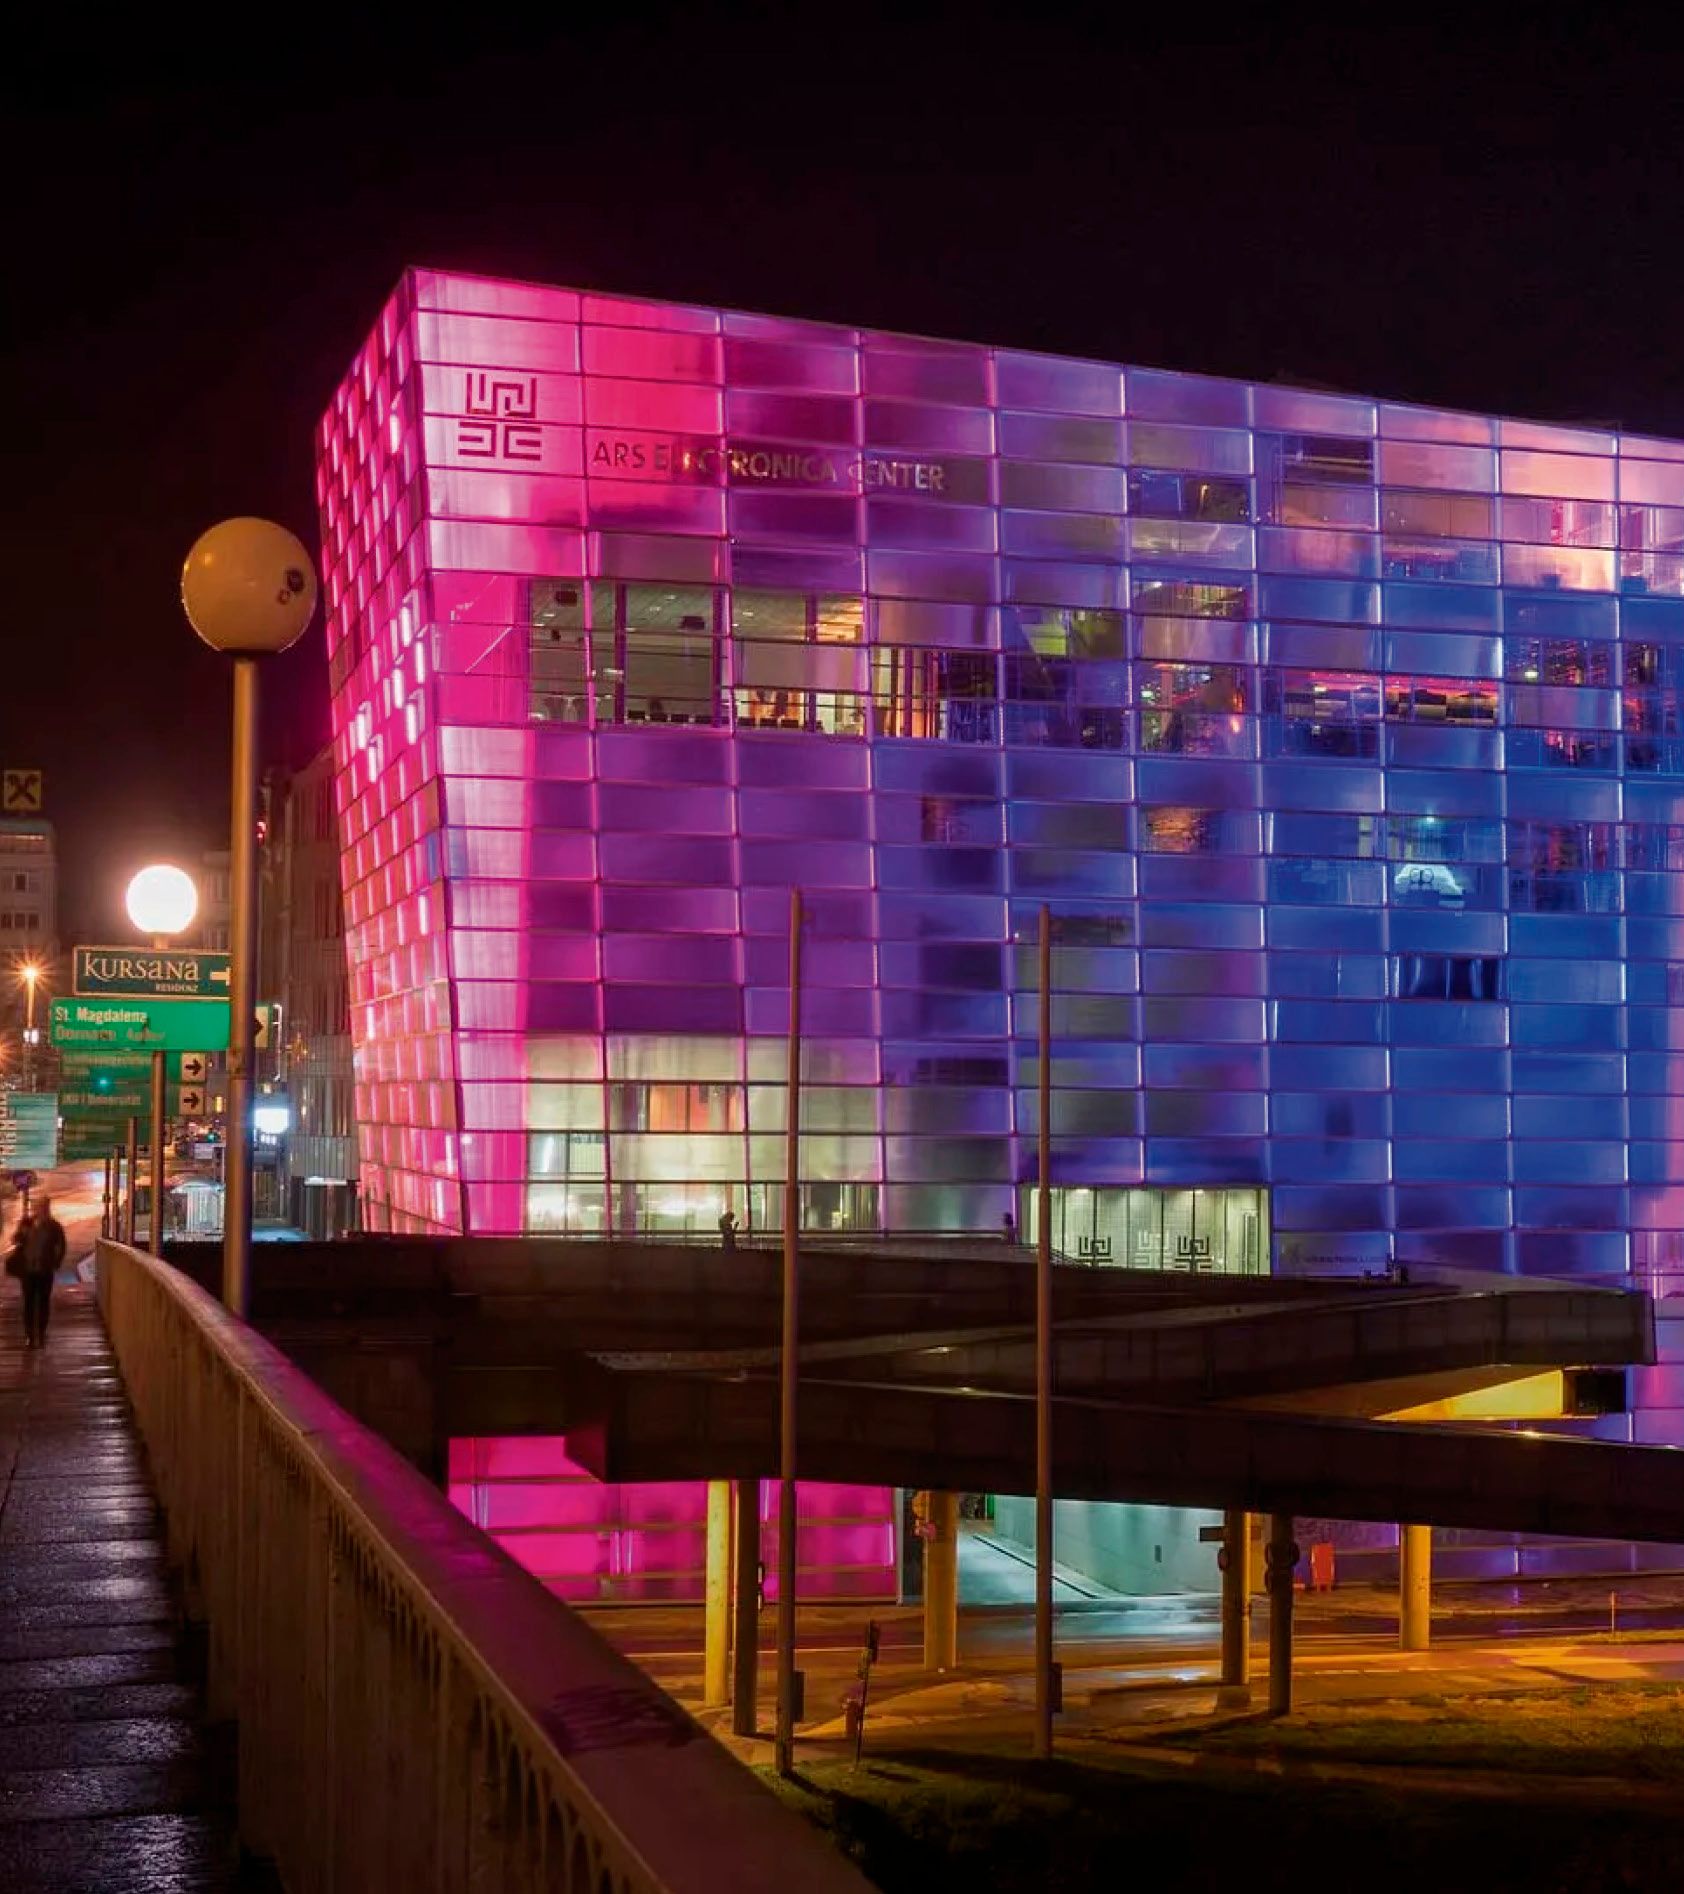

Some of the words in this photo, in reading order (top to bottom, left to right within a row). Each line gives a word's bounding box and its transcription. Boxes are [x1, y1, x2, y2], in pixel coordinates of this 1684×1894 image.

[593, 441, 645, 468] ARS
[848, 458, 945, 490] CENTER
[76, 1006, 148, 1024] Magdalena
